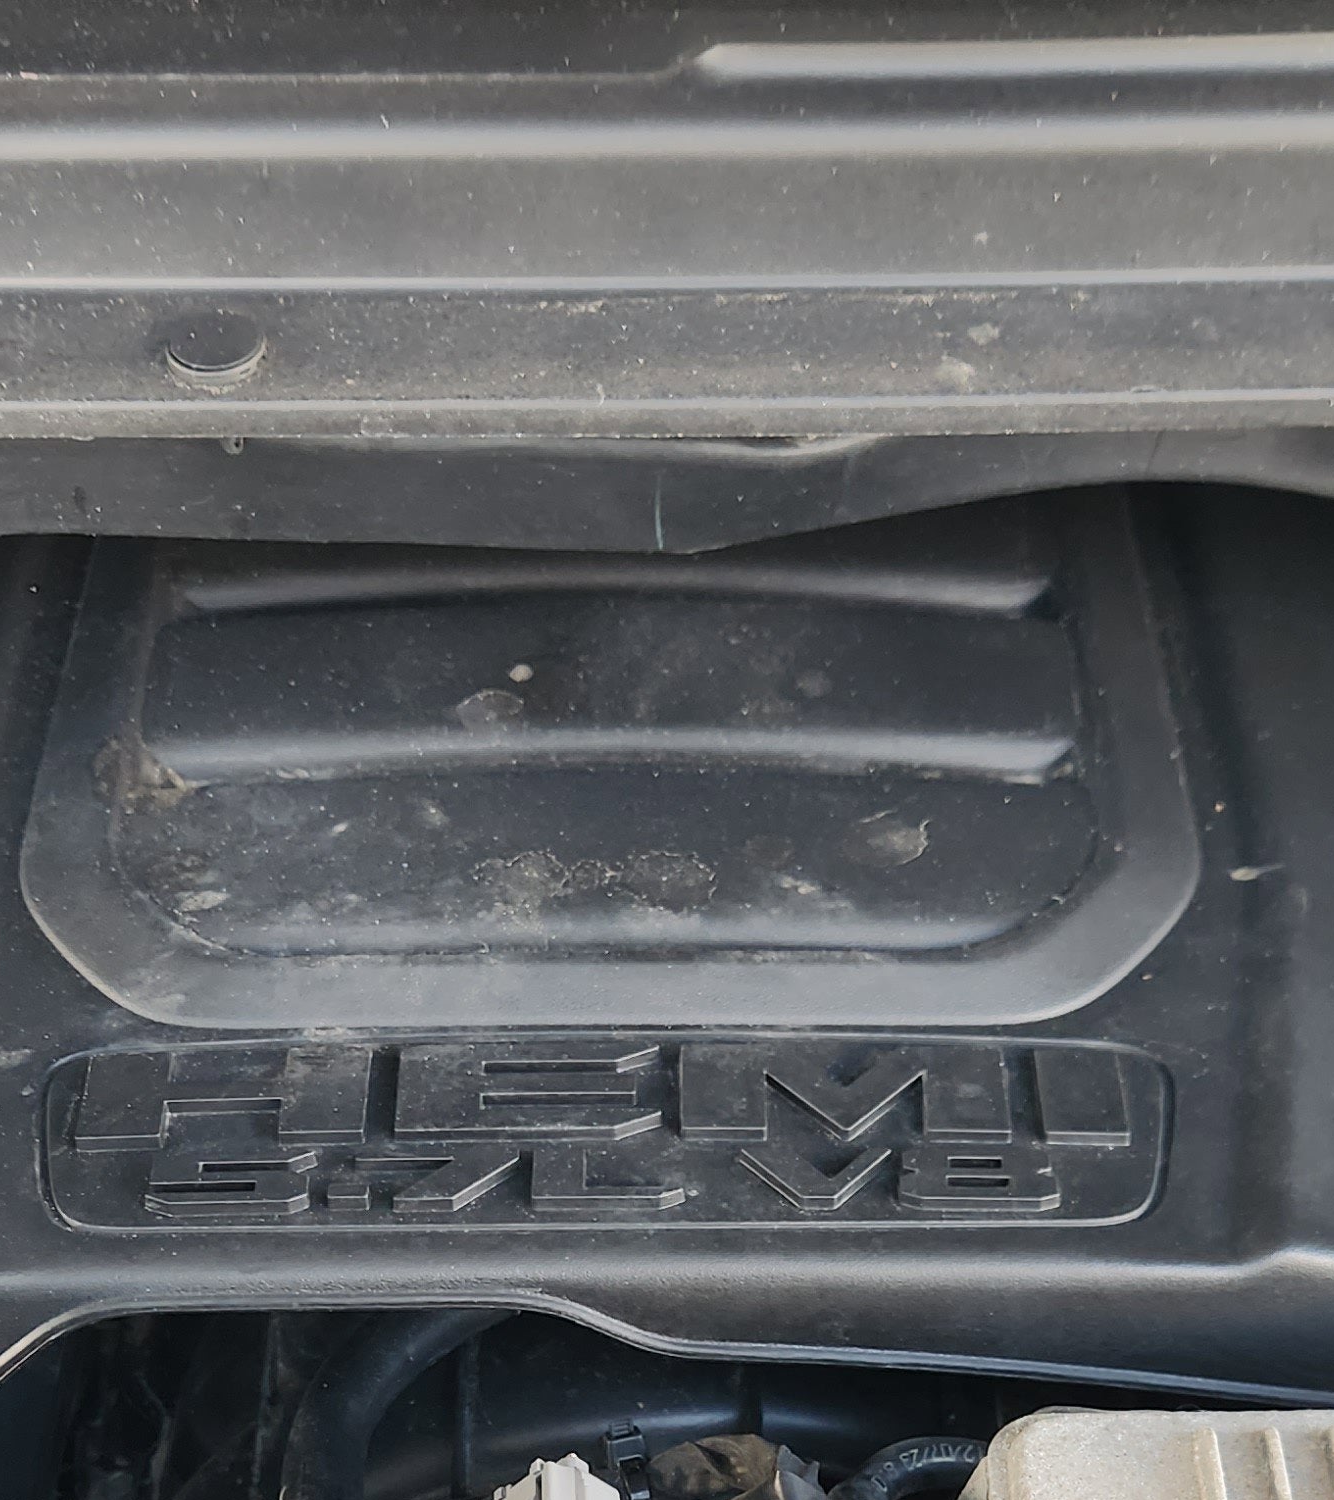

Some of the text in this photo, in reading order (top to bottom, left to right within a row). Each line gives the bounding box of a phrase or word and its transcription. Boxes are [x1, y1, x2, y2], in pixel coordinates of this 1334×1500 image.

[74, 1041, 1131, 1146] HEMI
[145, 1146, 1062, 1217] 5.7L V8
